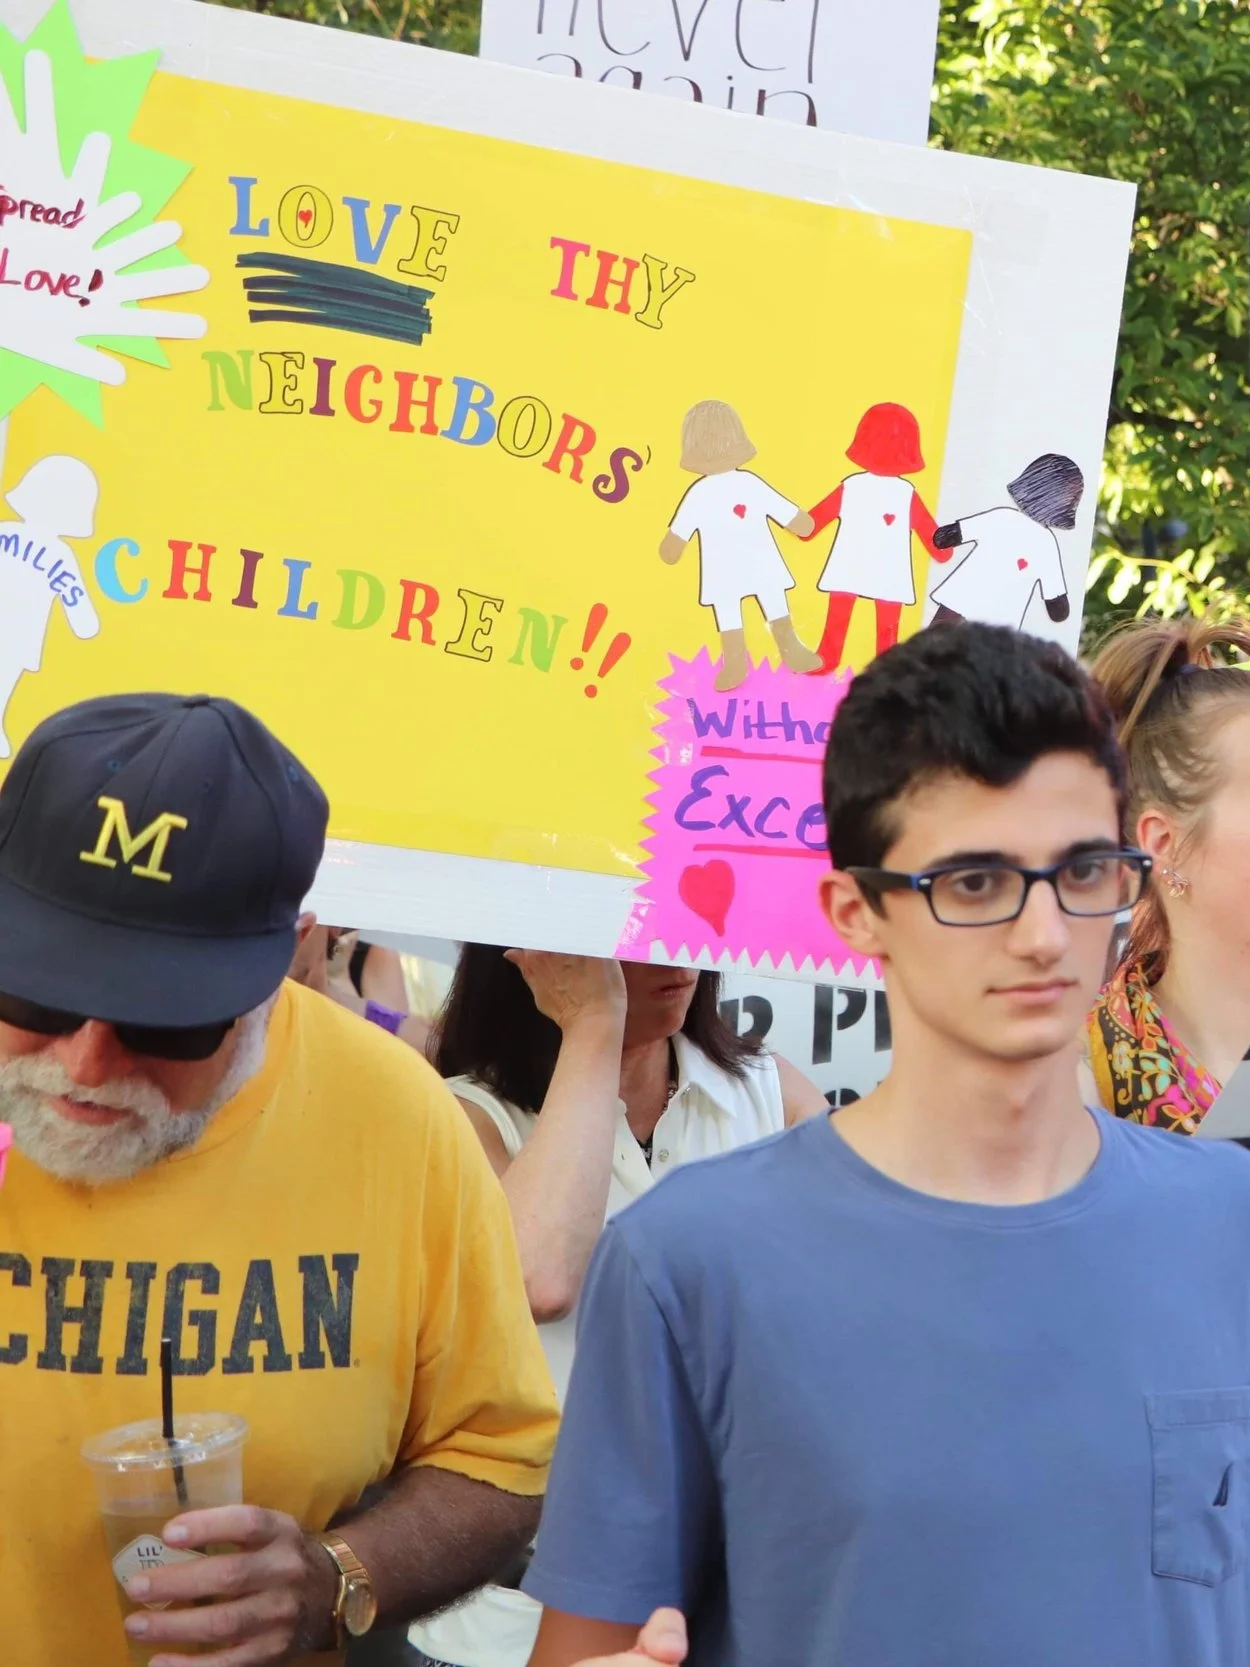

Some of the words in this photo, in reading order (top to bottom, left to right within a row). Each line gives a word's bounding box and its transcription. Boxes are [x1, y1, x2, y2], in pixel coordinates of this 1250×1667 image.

[0, 184, 87, 229] pread
[228, 176, 460, 281] LOVE
[549, 236, 696, 330] THY
[79, 795, 188, 882] M
